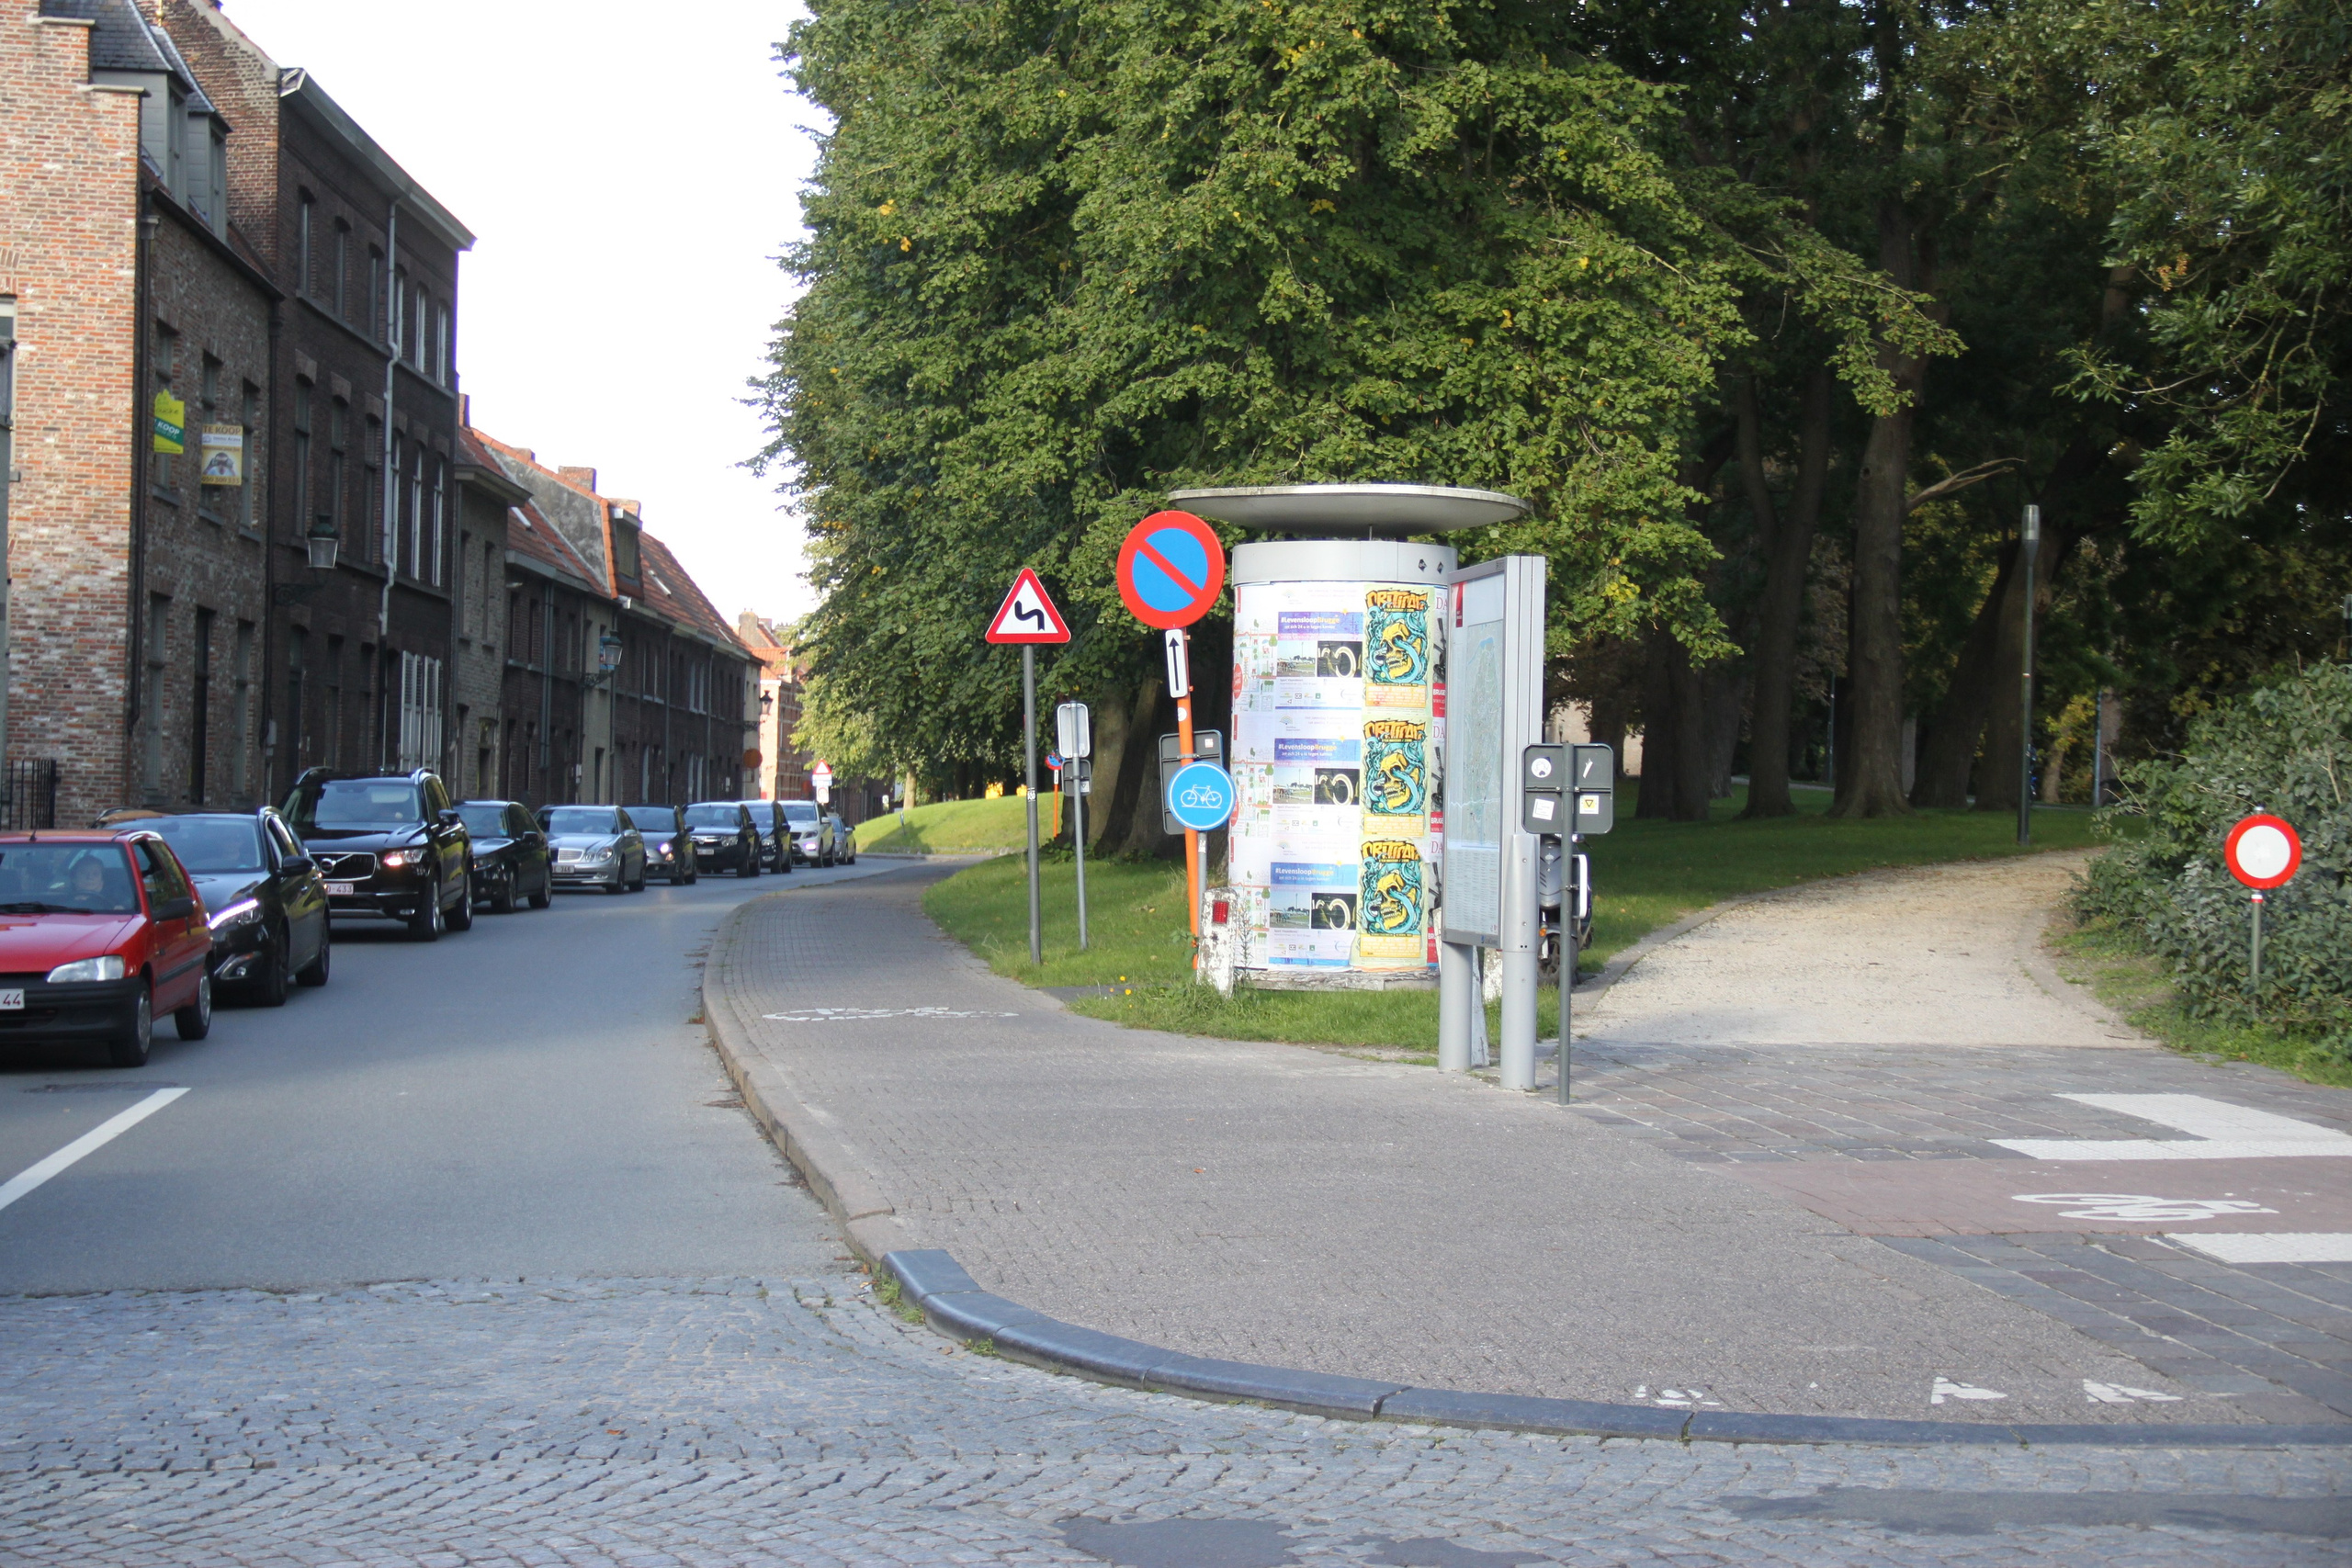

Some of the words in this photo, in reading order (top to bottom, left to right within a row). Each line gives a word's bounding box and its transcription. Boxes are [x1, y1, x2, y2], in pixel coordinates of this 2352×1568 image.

[158, 421, 180, 434] KOOP
[204, 425, 213, 434] TE
[215, 426, 241, 434] KOOP
